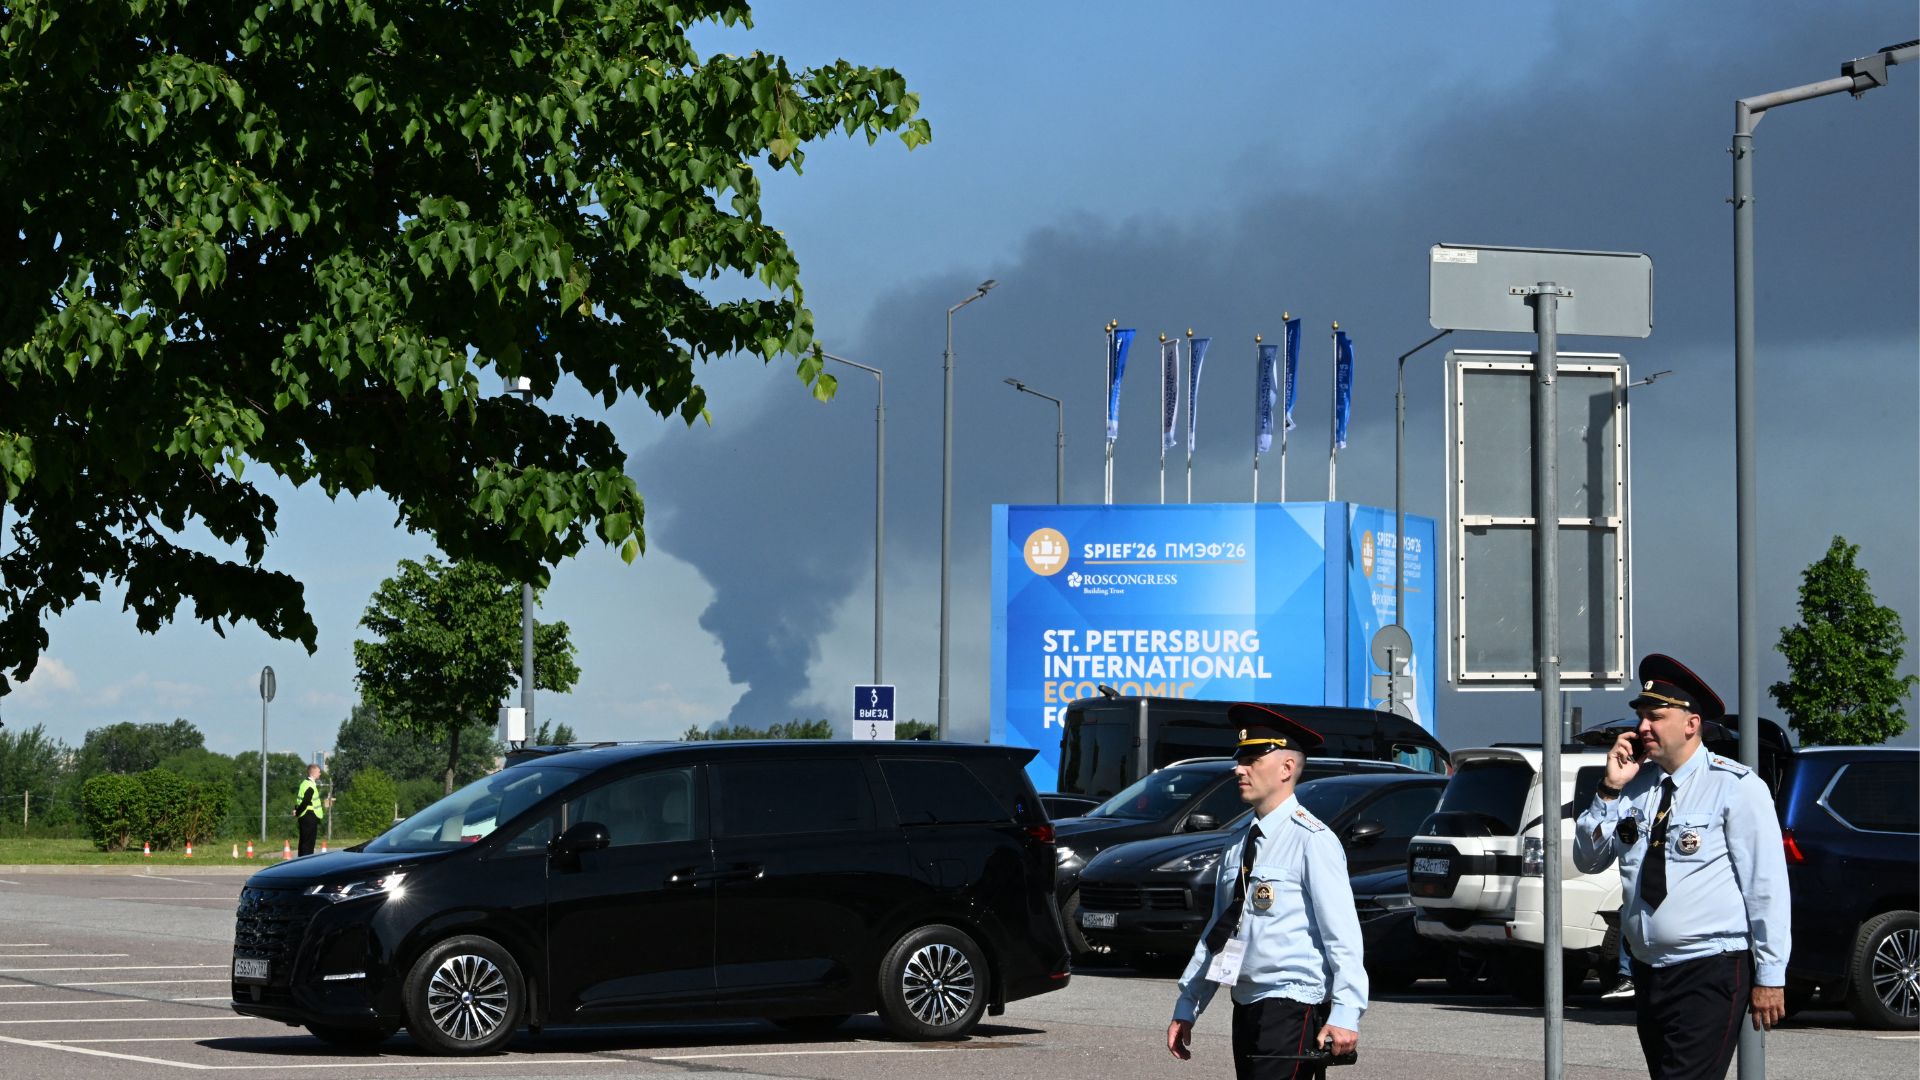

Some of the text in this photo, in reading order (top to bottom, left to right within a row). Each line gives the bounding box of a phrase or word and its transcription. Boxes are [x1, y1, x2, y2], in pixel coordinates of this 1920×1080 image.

[1084, 542, 1246, 559] SPIEF'26 ПМЭФ'26
[1084, 574, 1178, 585] ROSCONGRESS
[1083, 587, 1109, 596] Building
[1043, 629, 1260, 652] ST. PETERSBURG
[1044, 655, 1272, 678] INTERNATIONAL
[859, 709, 889, 719] ВЫЕЗД
